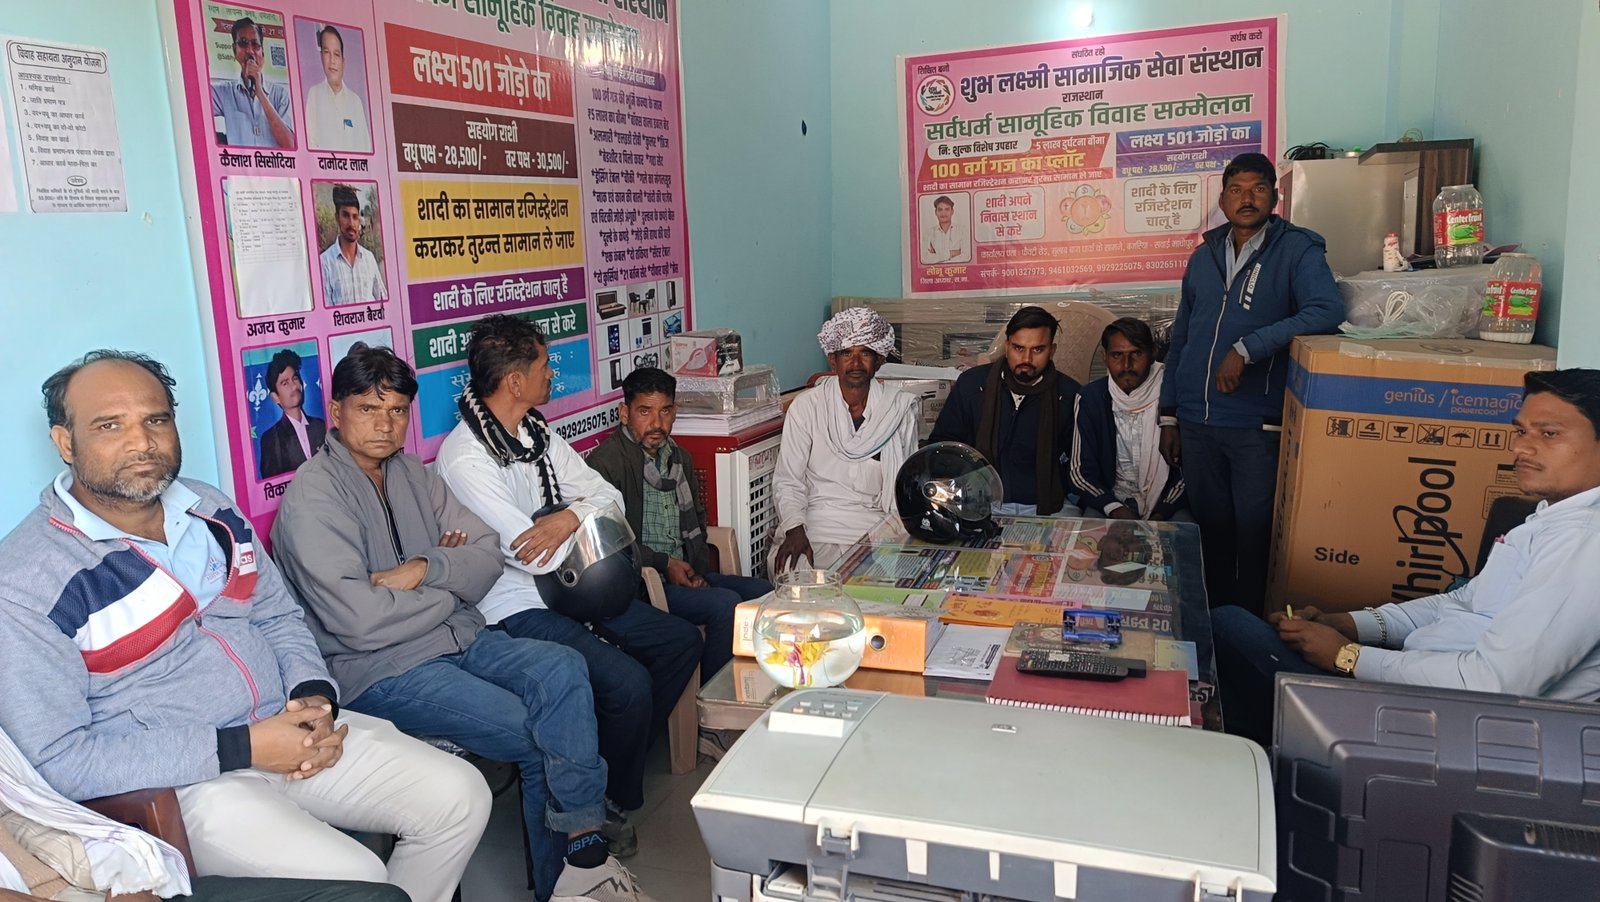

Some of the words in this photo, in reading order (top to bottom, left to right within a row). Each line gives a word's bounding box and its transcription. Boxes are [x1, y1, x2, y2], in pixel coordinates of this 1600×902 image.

[539, 1, 581, 37] विवाह
[1248, 29, 1262, 41] करो
[17, 45, 35, 61] विवाह
[36, 51, 60, 63] सहायता
[61, 54, 83, 68] अनुदान
[83, 53, 102, 68] योजना
[1094, 45, 1105, 57] रहो
[409, 46, 457, 87] लक्ष्य
[461, 56, 493, 93] 501
[493, 54, 530, 105] जोड़ो
[530, 70, 551, 101] का
[937, 62, 949, 73] बनो
[960, 74, 994, 103] शुभ
[996, 62, 1050, 93] लक्ष्मी
[1053, 56, 1143, 87] सामाजिक
[1145, 51, 1186, 78] सेवा
[1188, 46, 1264, 74] संस्थान
[1062, 88, 1103, 103] राजस्थान
[924, 112, 993, 141] सर्वधर्म
[996, 106, 1085, 136] सामूहिक
[1088, 102, 1149, 126] विवाह
[1151, 93, 1254, 120] सम्मेलन
[466, 117, 498, 141] सहयोग
[498, 119, 518, 143] राशी
[1129, 131, 1165, 149] लक्ष्य
[1166, 131, 1193, 145] 501
[1195, 124, 1229, 145] जोड़ो
[1230, 126, 1251, 140] का
[952, 145, 972, 157] शुल्क
[973, 140, 994, 153] विशेष
[995, 140, 1018, 152] उपहार
[1036, 141, 1041, 151] 5
[1042, 140, 1061, 151] लाख
[1062, 136, 1087, 150] दुर्घटना
[1087, 135, 1105, 146] बीमा
[219, 149, 252, 168] कैलाश
[254, 152, 296, 171] सिसोदिया
[317, 153, 348, 171] दामोदर
[349, 158, 369, 172] लाल
[402, 142, 419, 171] वधू
[418, 145, 437, 165] पक्ष
[444, 144, 487, 171] 28,500/-
[504, 150, 518, 168] वर
[517, 150, 531, 168] पक्ष
[536, 150, 569, 174] 30,500/-
[930, 163, 960, 179] 100
[962, 157, 988, 175] वर्ग
[989, 160, 1017, 174] गज
[1021, 156, 1042, 171] का
[1044, 149, 1087, 169] प्लॉट
[1166, 152, 1190, 162] सहयोग
[1191, 150, 1207, 161] राशी
[1205, 160, 1216, 169] पक्ष
[1132, 165, 1143, 174] पक्ष
[923, 182, 938, 192] शादी
[939, 182, 948, 190] का
[949, 180, 972, 190] सामान
[1053, 172, 1078, 183] सामान
[1131, 184, 1157, 198] शादी
[1159, 183, 1171, 196] के
[1172, 181, 1198, 195] लिए
[418, 190, 450, 220] शादी
[451, 199, 471, 220] का
[472, 199, 515, 219] सामान
[516, 191, 569, 220] रजिस्ट्रेशन
[986, 195, 1007, 208] शादी
[1008, 192, 1032, 207] अपने
[1135, 196, 1193, 213] रजिस्ट्रेशन
[980, 210, 1010, 223] निवास
[1011, 209, 1037, 221] स्थान
[1145, 215, 1173, 229] चालू
[1173, 212, 1182, 226] है
[995, 225, 1006, 237] से
[1006, 223, 1022, 237] करे
[412, 236, 465, 259] कराकर
[466, 234, 501, 264] तुरन्त
[502, 232, 541, 253] सामान
[542, 226, 553, 250] ले
[554, 231, 575, 249] जाए
[926, 265, 943, 277] सोनू
[944, 266, 967, 277] कुमार
[433, 285, 459, 311] शादी
[460, 283, 472, 307] के
[472, 281, 495, 306] लिए
[496, 277, 541, 302] रजिस्ट्रेशन
[543, 278, 563, 300] चालू
[562, 273, 569, 294] है
[246, 320, 275, 337] अजय
[277, 316, 306, 334] कुमार
[333, 309, 365, 327] शिवराज
[429, 328, 458, 358] शादी
[550, 312, 561, 335] से
[562, 309, 577, 332] करे
[1384, 388, 1435, 405] genius
[1450, 388, 1523, 411] icemagic
[1450, 407, 1499, 416] powercool
[1314, 546, 1361, 566] Side
